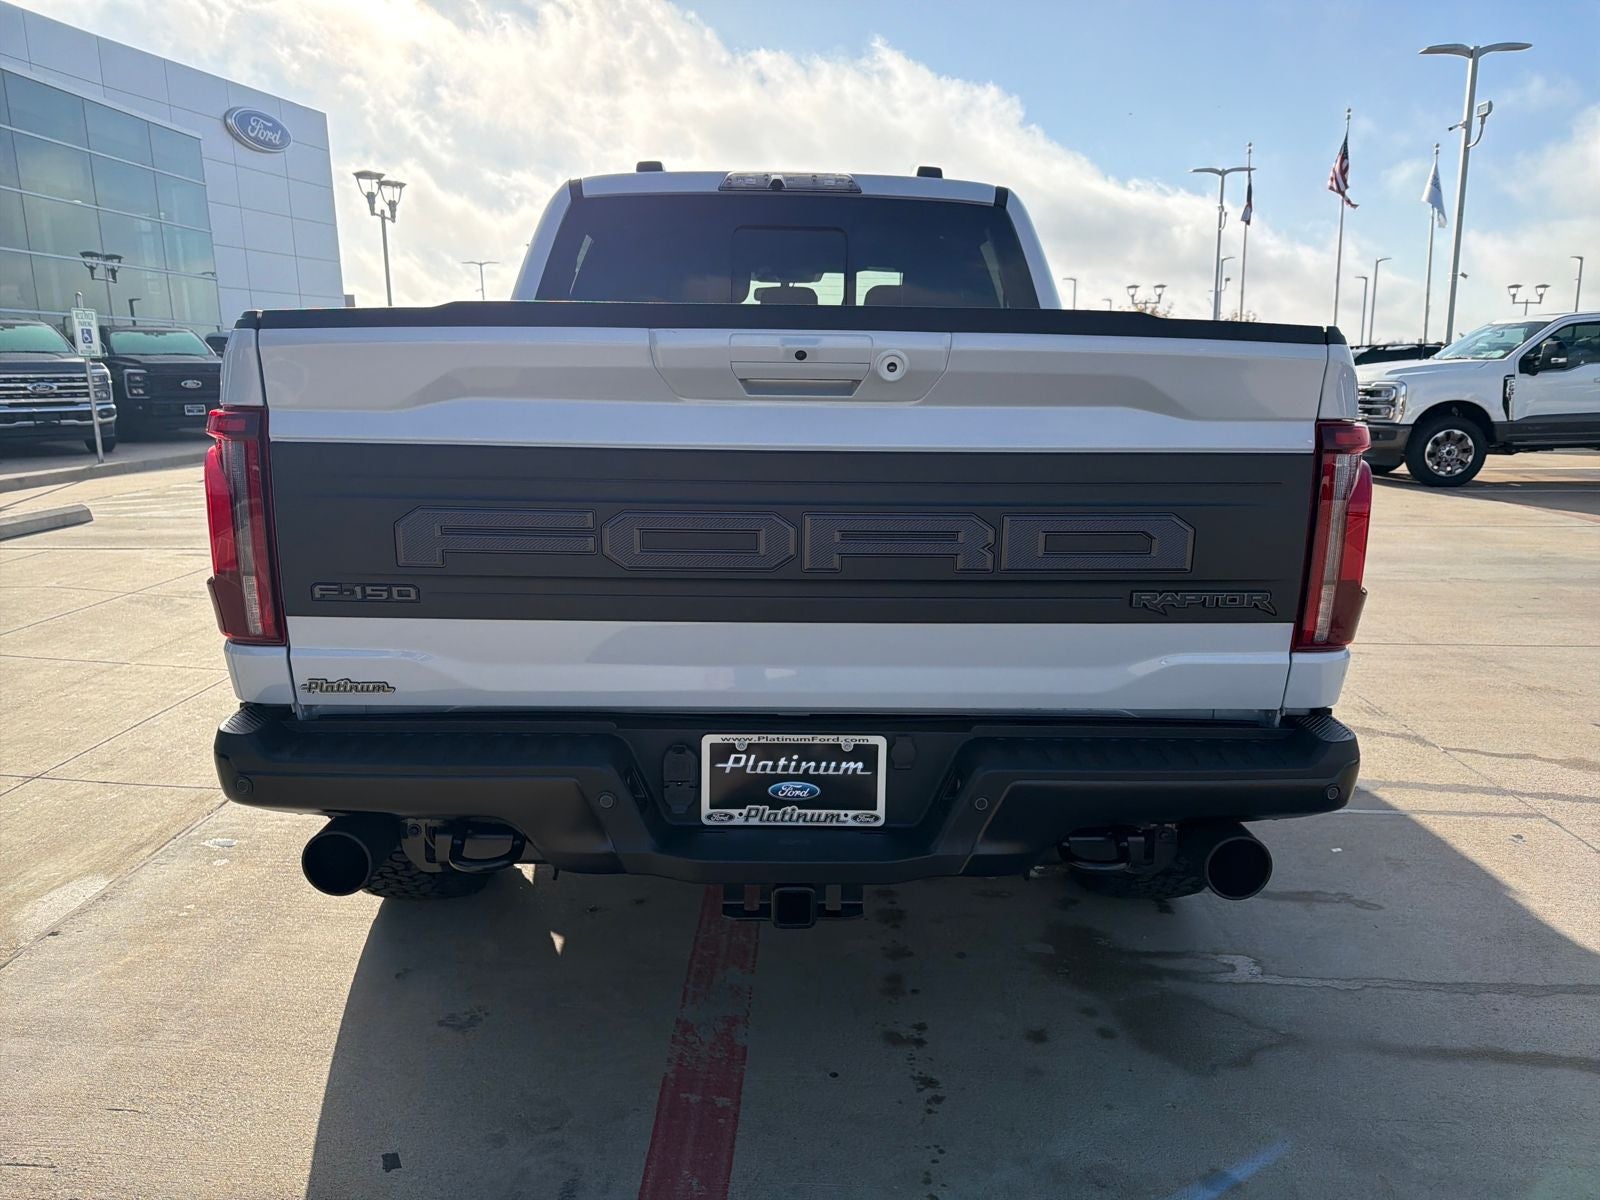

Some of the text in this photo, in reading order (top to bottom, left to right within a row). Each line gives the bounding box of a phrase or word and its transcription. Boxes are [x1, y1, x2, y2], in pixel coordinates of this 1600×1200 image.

[248, 116, 282, 145] Ford
[394, 506, 1196, 573] FORD
[312, 583, 420, 602] F-150
[1131, 591, 1277, 616] RAPTOR
[301, 678, 396, 694] Platinum
[721, 735, 869, 743] www.PlatinumFord.com
[714, 753, 873, 775] Platinum
[778, 784, 810, 797] Ford
[710, 812, 730, 821] Ford
[744, 805, 850, 824] Platinum
[857, 814, 877, 823] Ford
